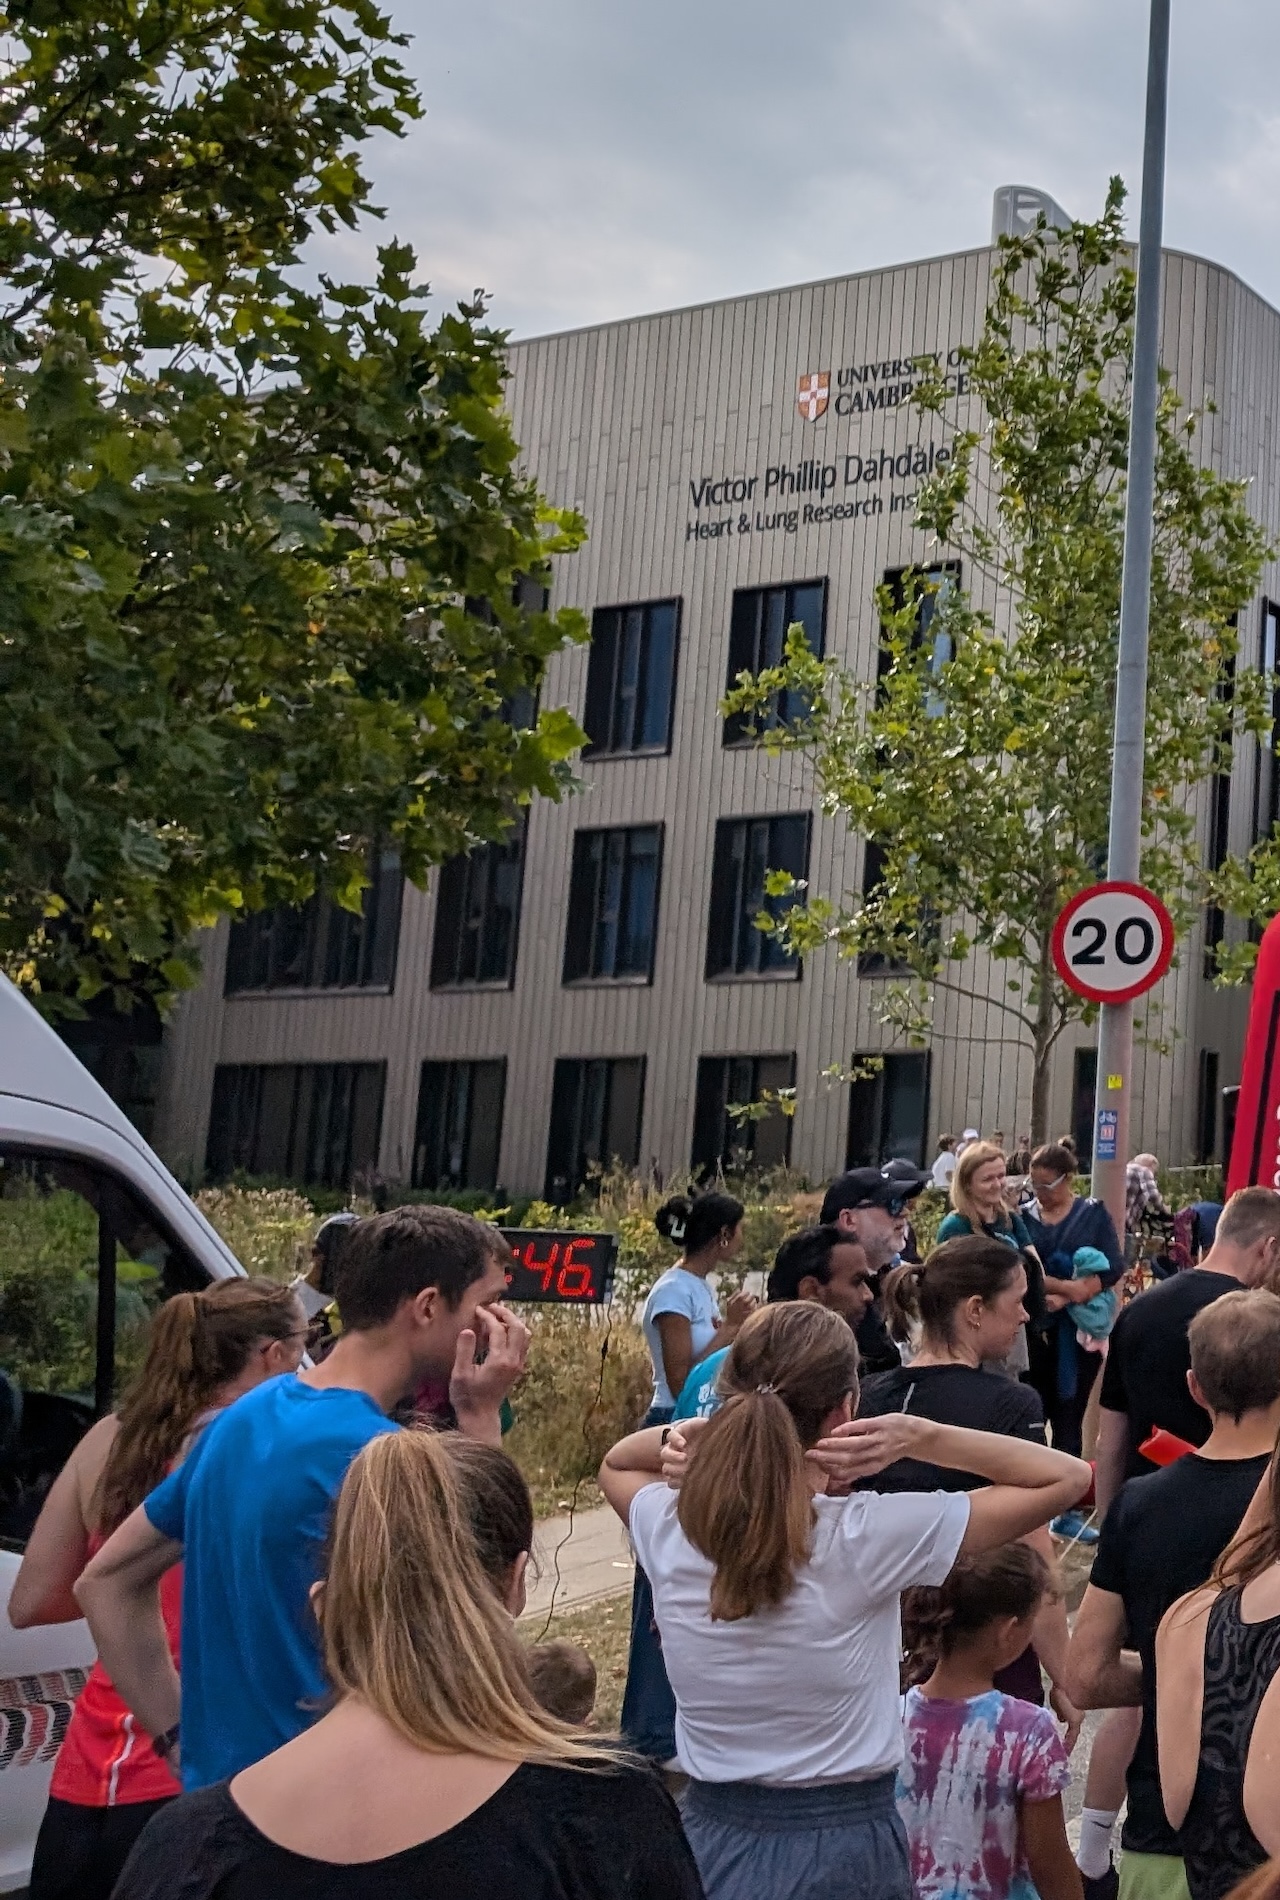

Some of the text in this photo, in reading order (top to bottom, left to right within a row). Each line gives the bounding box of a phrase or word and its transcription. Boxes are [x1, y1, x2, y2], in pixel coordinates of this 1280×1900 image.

[837, 351, 943, 388] UNIVERSIY
[689, 476, 759, 508] Victor
[764, 459, 837, 499] Phillip
[686, 515, 732, 542] Heart
[737, 513, 751, 532] &
[755, 508, 800, 533] Lung
[803, 493, 883, 525] Research
[1071, 917, 1155, 966] 20
